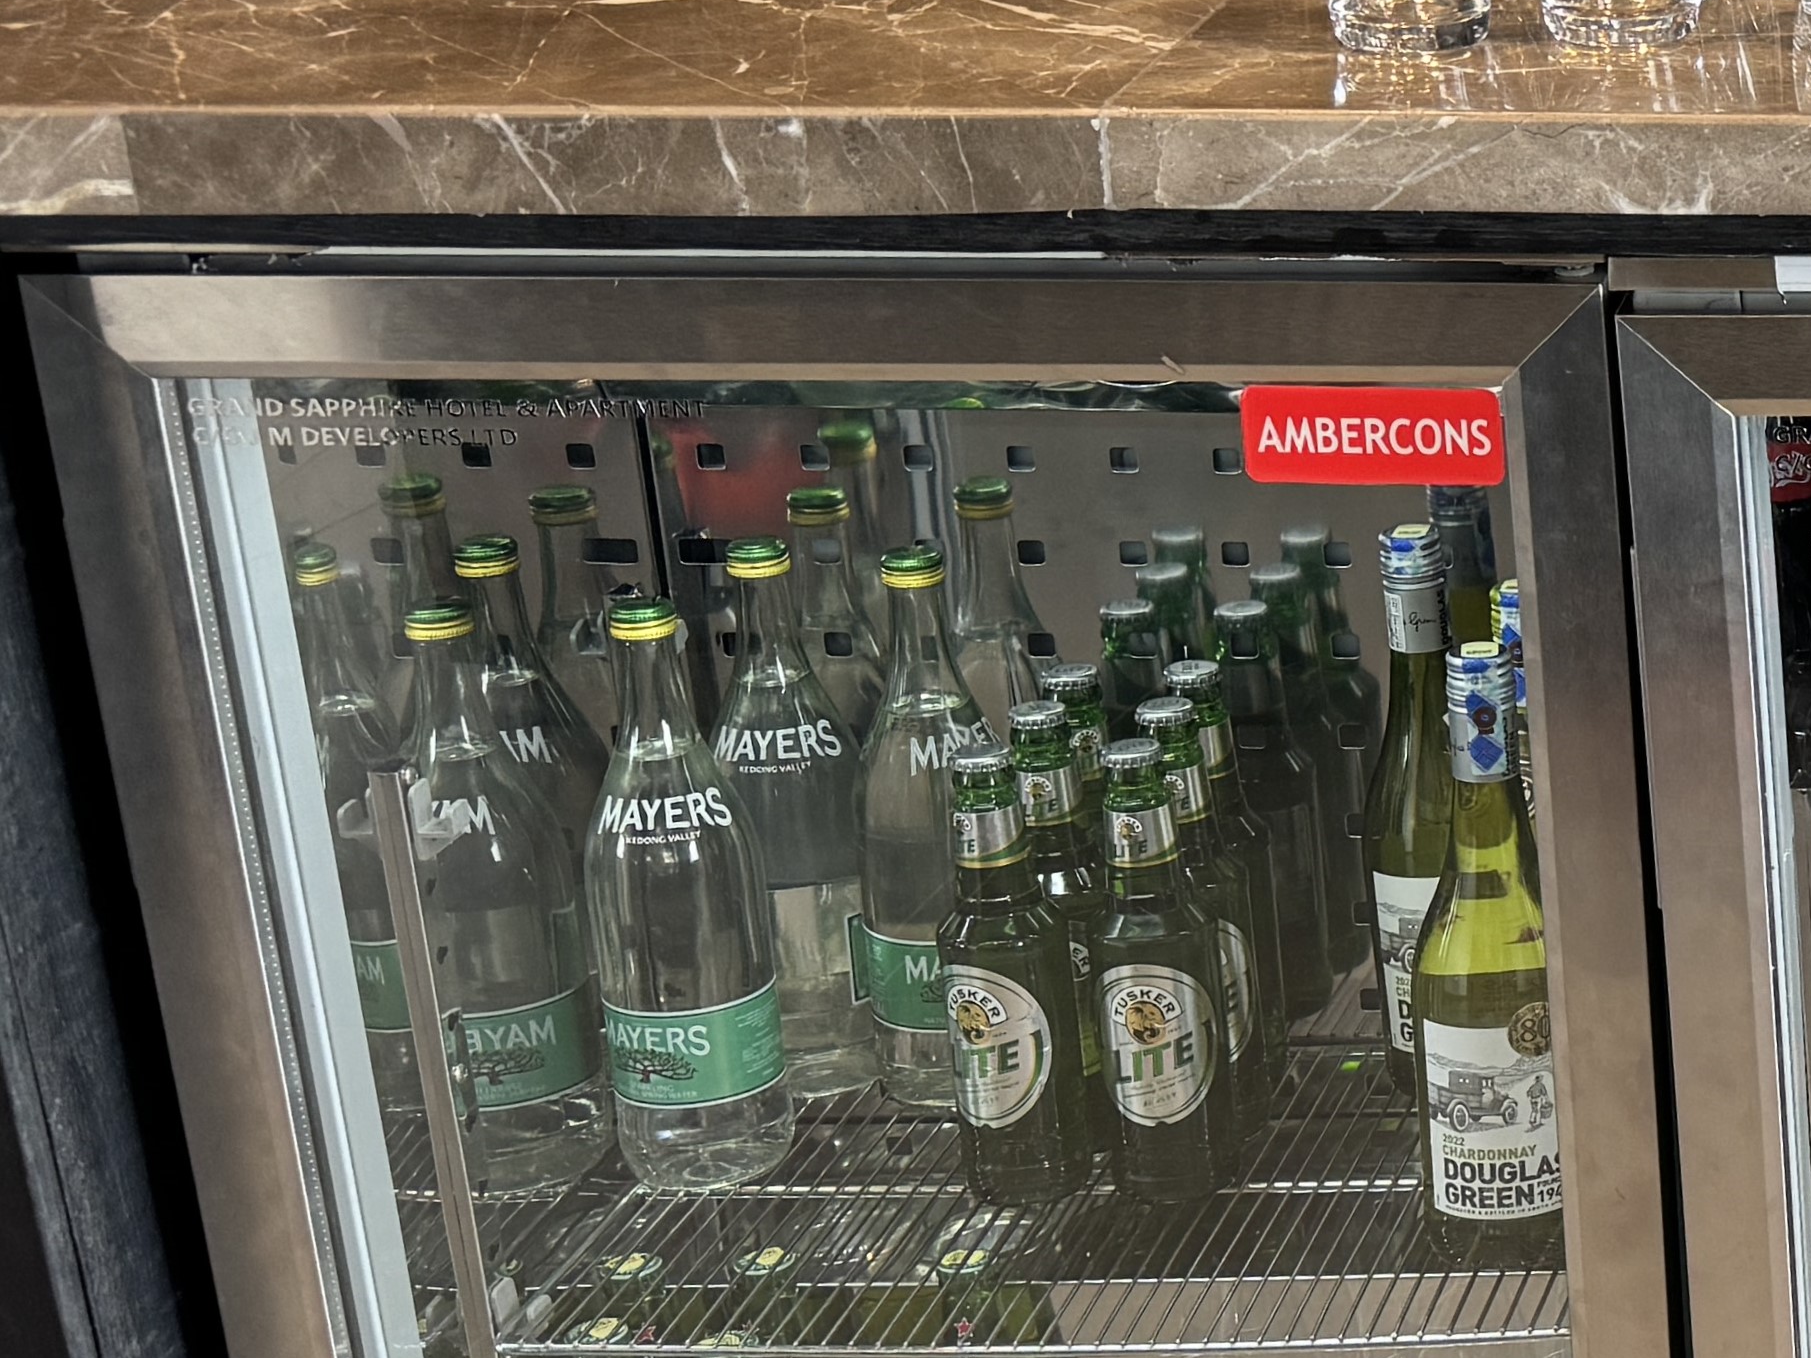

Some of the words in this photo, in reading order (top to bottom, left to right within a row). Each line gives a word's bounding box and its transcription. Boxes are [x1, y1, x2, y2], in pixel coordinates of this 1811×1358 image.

[290, 397, 417, 419] SAPPHIRE
[424, 398, 508, 419] HOTEL
[517, 399, 539, 419] &
[546, 398, 708, 420] APARTMENT
[268, 426, 293, 447] M
[300, 426, 461, 448] DEVELOPERS
[462, 428, 518, 448] LTD
[1257, 415, 1493, 458] AMBERCONS
[713, 718, 842, 764] MAYERS
[597, 786, 733, 835] MAYERS
[667, 830, 702, 844] VALLEY
[1114, 988, 1176, 1018] TUSKER
[603, 1014, 711, 1056] MAYERS
[1114, 1031, 1194, 1084] LITE
[1442, 1133, 1466, 1147] 2022
[1442, 1144, 1537, 1161] CHARDONNAY
[1445, 1182, 1535, 1209] GREEN
